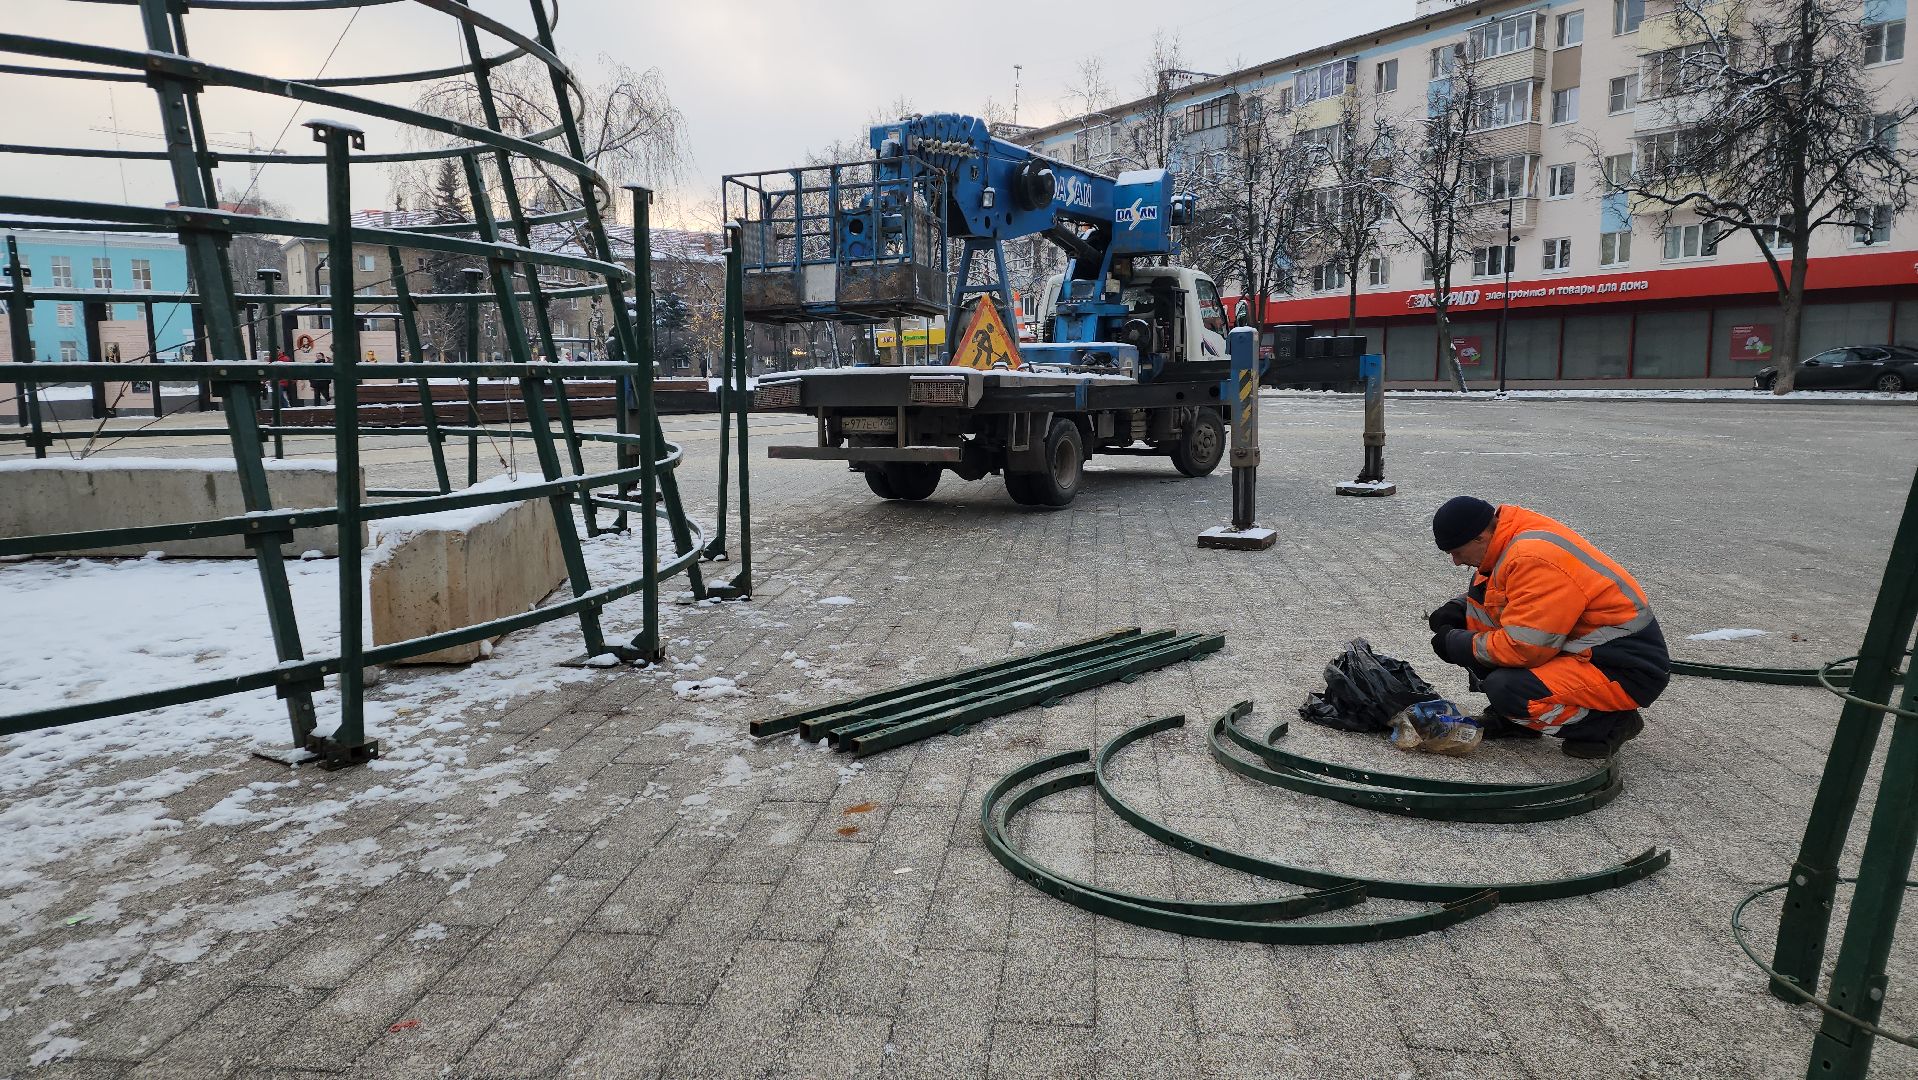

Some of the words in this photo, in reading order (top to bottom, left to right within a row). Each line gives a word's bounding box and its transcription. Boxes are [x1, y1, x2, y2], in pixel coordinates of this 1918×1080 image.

[1053, 175, 1092, 208] ASAN
[1115, 198, 1158, 231] DASAN
[1485, 287, 1547, 301] электроника
[1548, 287, 1556, 296] и
[1557, 284, 1596, 296] товары
[1597, 282, 1617, 294] для
[1619, 280, 1649, 293] дома
